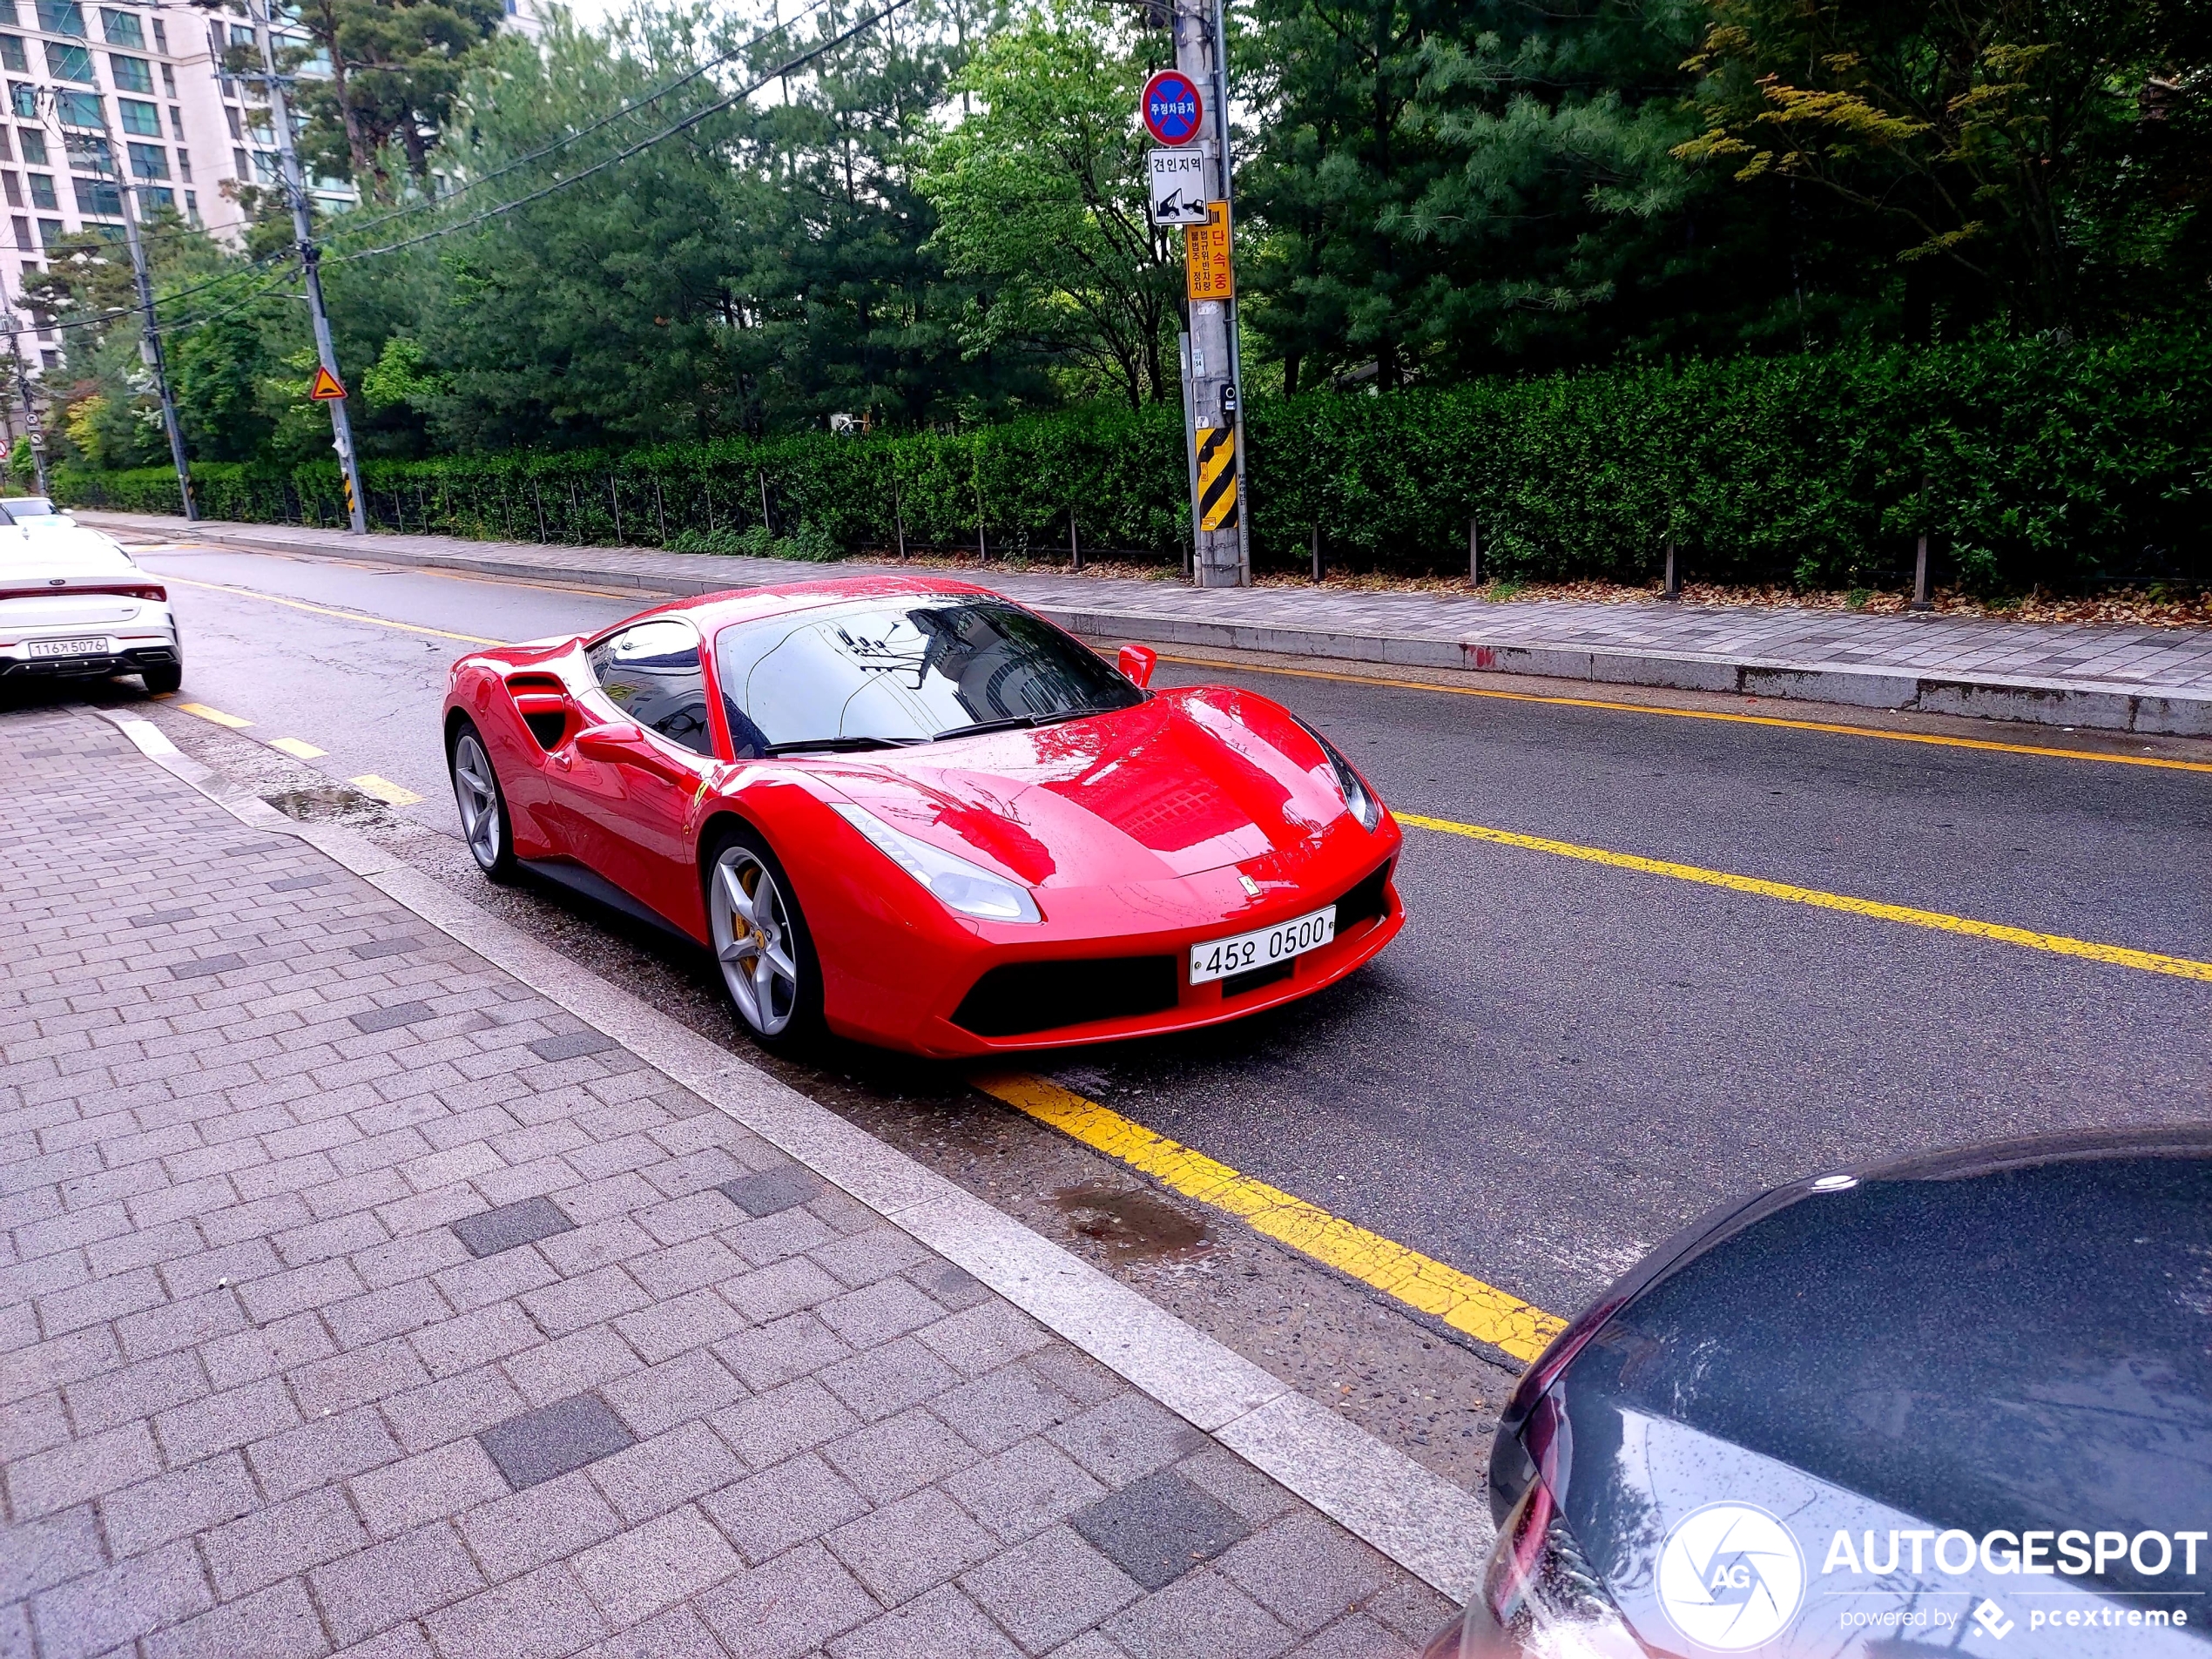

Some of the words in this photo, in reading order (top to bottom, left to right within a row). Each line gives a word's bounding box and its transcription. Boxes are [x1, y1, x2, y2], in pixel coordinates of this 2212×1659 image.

[1150, 102, 1195, 115] 주정차금지
[1154, 157, 1202, 172] 견인지역
[71, 640, 103, 652] 5076
[1206, 941, 1256, 974] 45오
[1269, 916, 1325, 959] 0500
